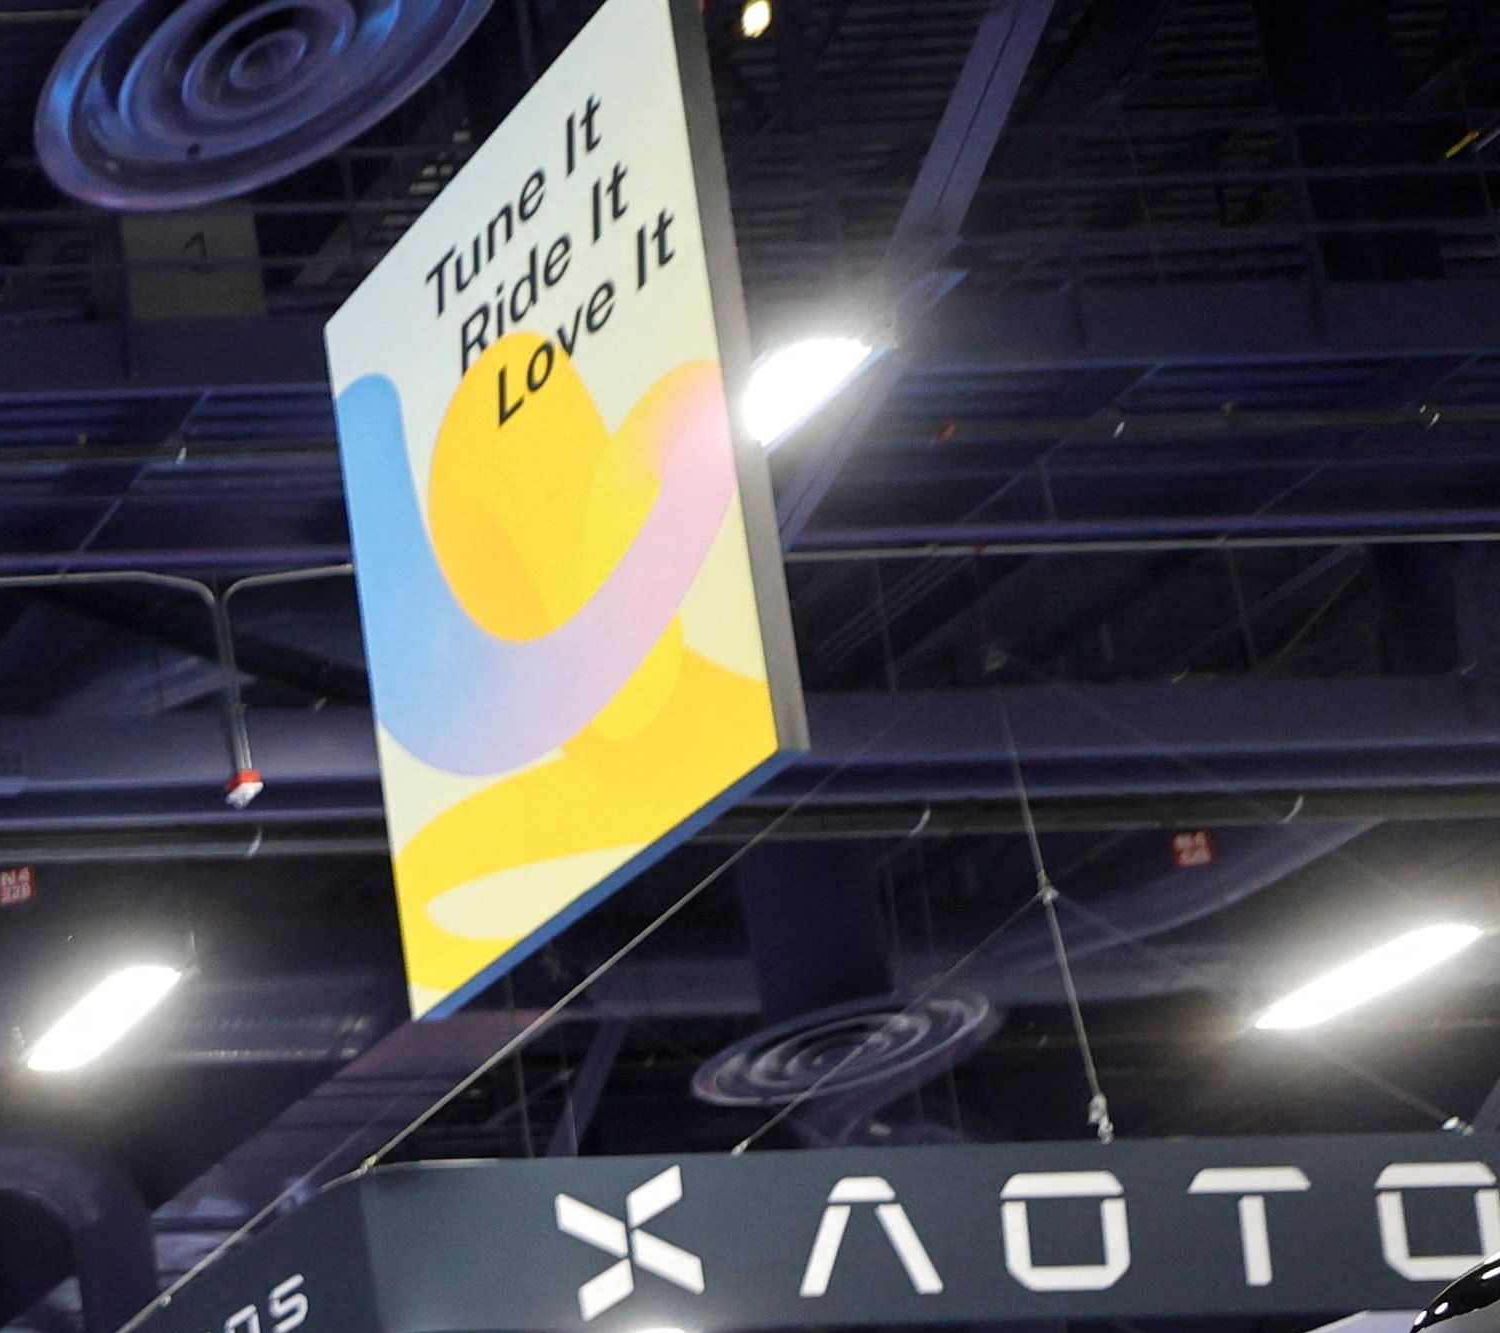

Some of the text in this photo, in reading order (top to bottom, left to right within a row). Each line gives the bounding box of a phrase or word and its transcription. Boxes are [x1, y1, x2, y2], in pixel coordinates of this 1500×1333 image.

[426, 92, 604, 318] Tune It
[460, 159, 630, 379] Ride It
[497, 206, 677, 432] Love It
